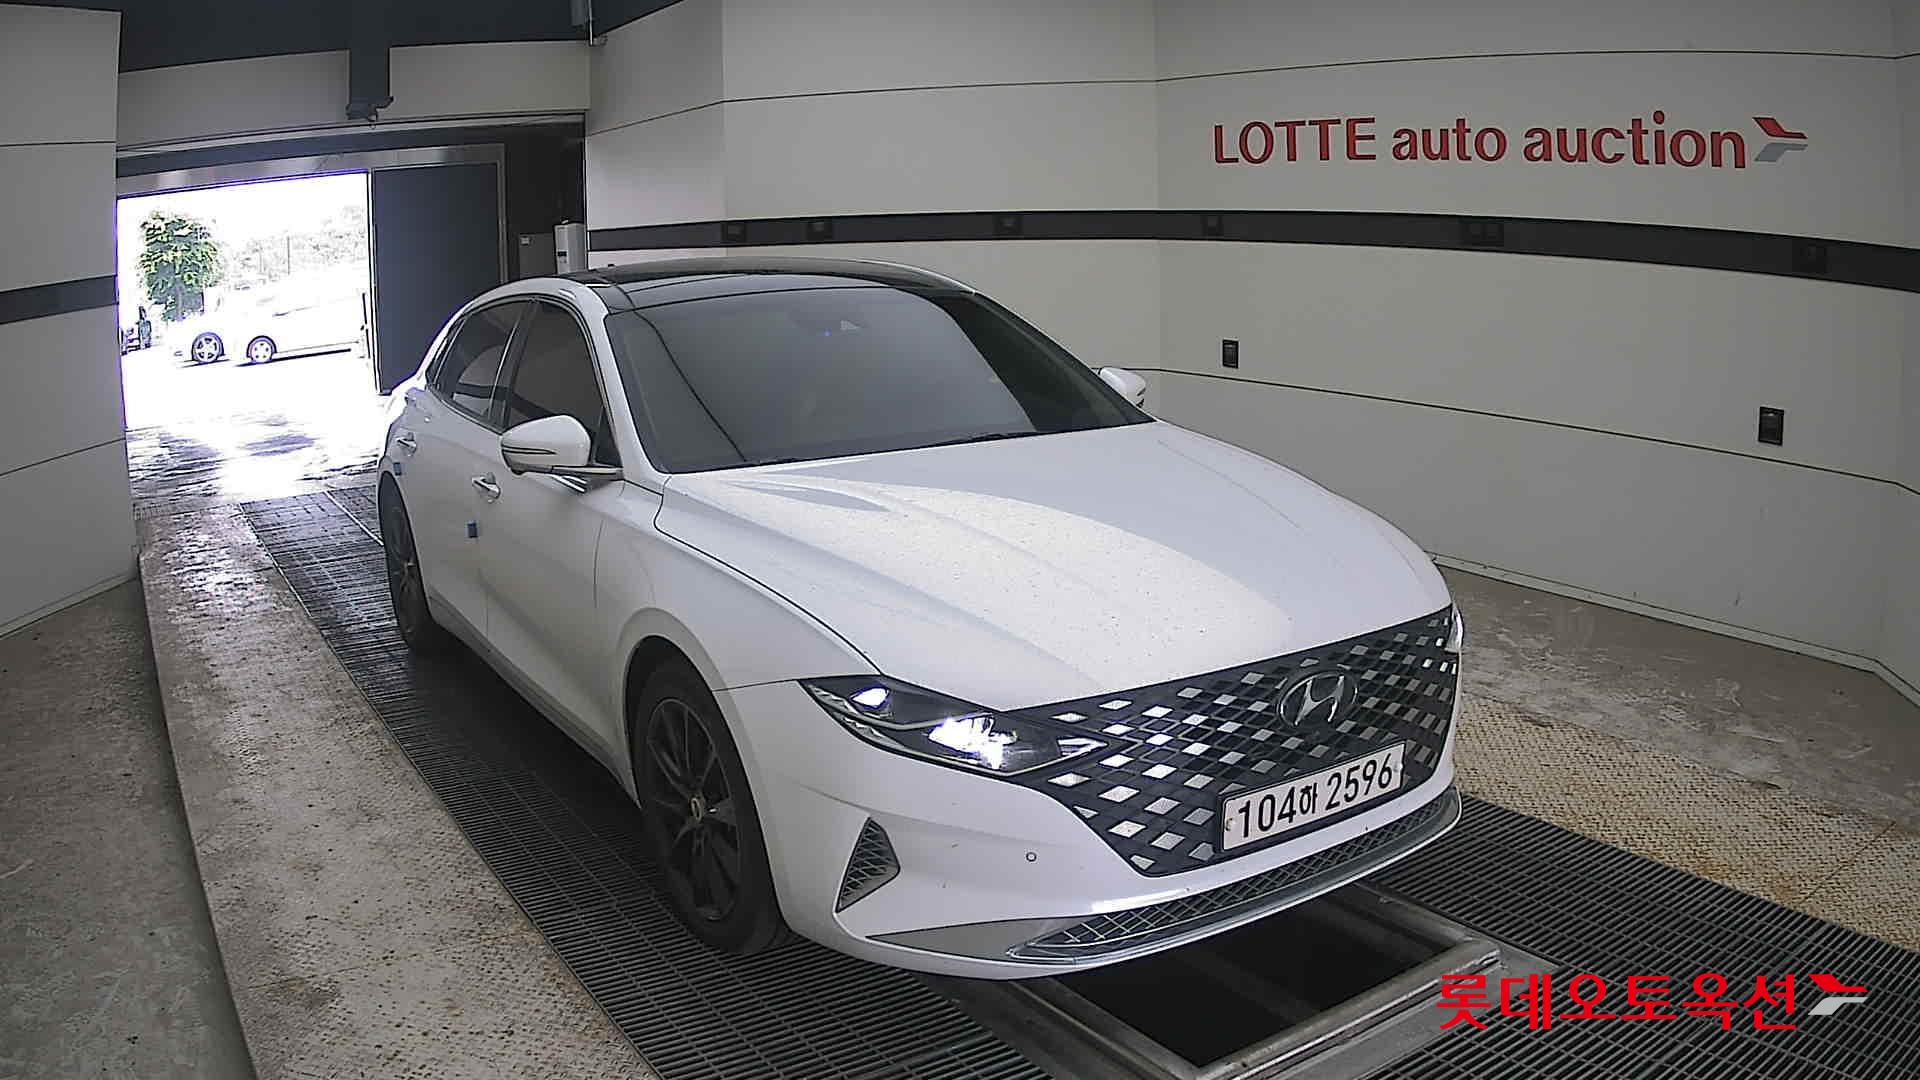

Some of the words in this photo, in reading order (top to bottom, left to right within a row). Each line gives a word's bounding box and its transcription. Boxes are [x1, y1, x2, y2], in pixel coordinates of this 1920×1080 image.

[1213, 117, 1377, 163] LOTTE
[1391, 117, 1508, 162] auto
[1522, 110, 1747, 169] auction
[1238, 782, 1318, 839] 104하
[1325, 752, 1393, 811] 2596
